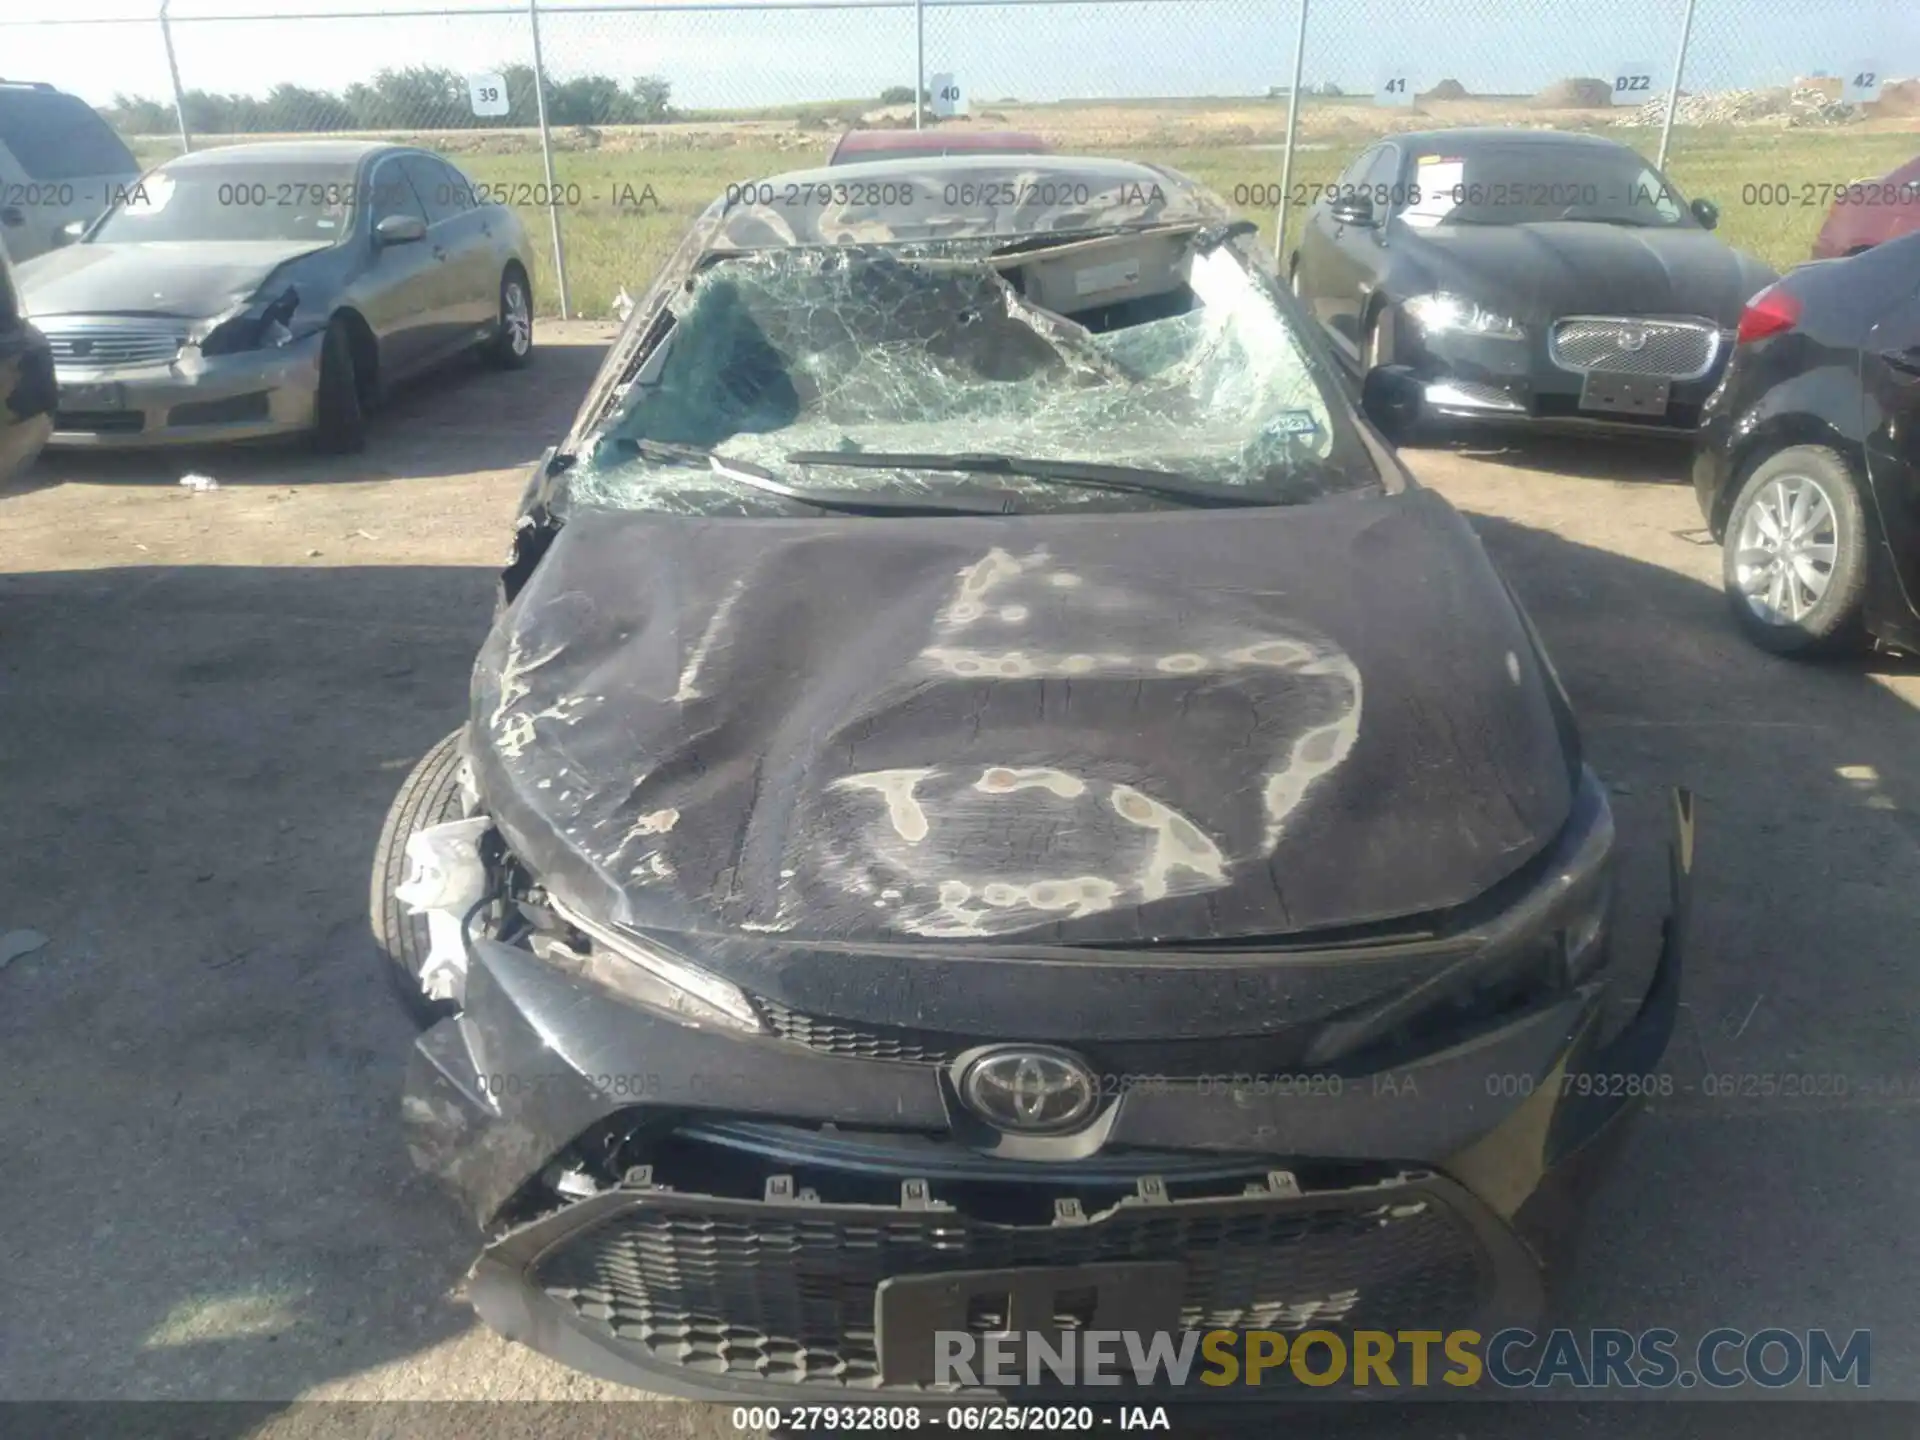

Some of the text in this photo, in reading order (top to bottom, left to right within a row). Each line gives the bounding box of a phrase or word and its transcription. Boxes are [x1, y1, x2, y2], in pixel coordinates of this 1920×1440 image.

[1384, 78, 1406, 94] 41
[1853, 72, 1876, 89] 42
[479, 88, 498, 102] 39
[940, 86, 960, 102] 40
